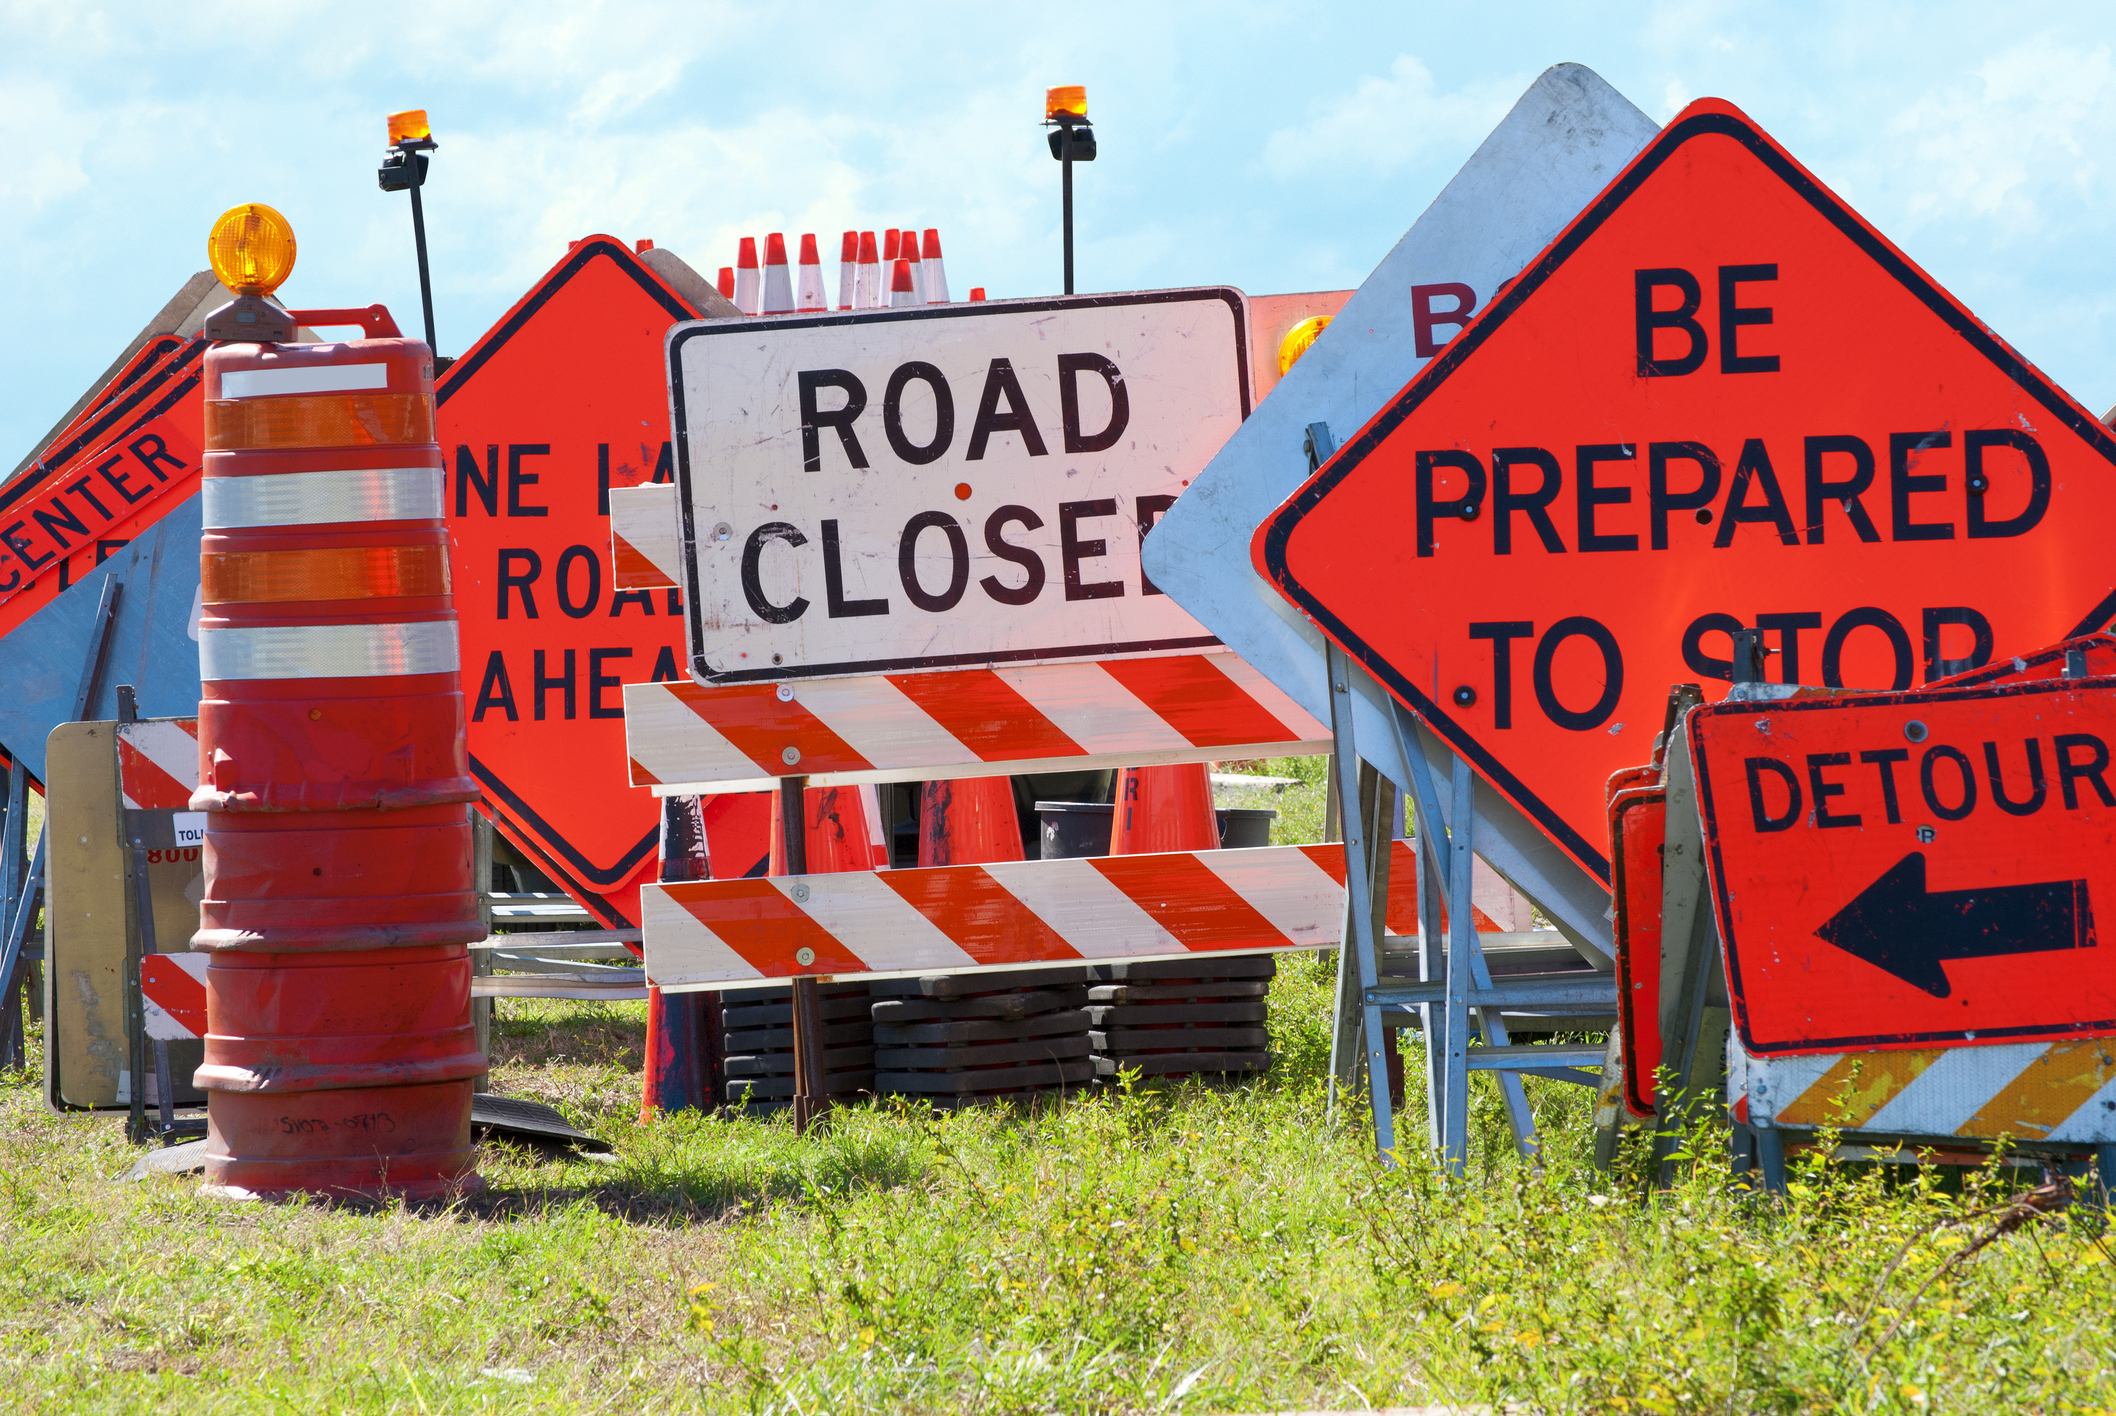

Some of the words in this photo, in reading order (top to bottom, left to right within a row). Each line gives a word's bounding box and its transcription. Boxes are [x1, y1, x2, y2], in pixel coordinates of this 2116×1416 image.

[1411, 277, 1516, 359] B
[1635, 264, 1780, 378] BE
[798, 352, 1130, 472] ROAD
[442, 443, 551, 517] NE
[1416, 429, 2052, 558] PREPARED
[1470, 615, 1624, 732] TO
[1744, 733, 2116, 833] DETOUR
